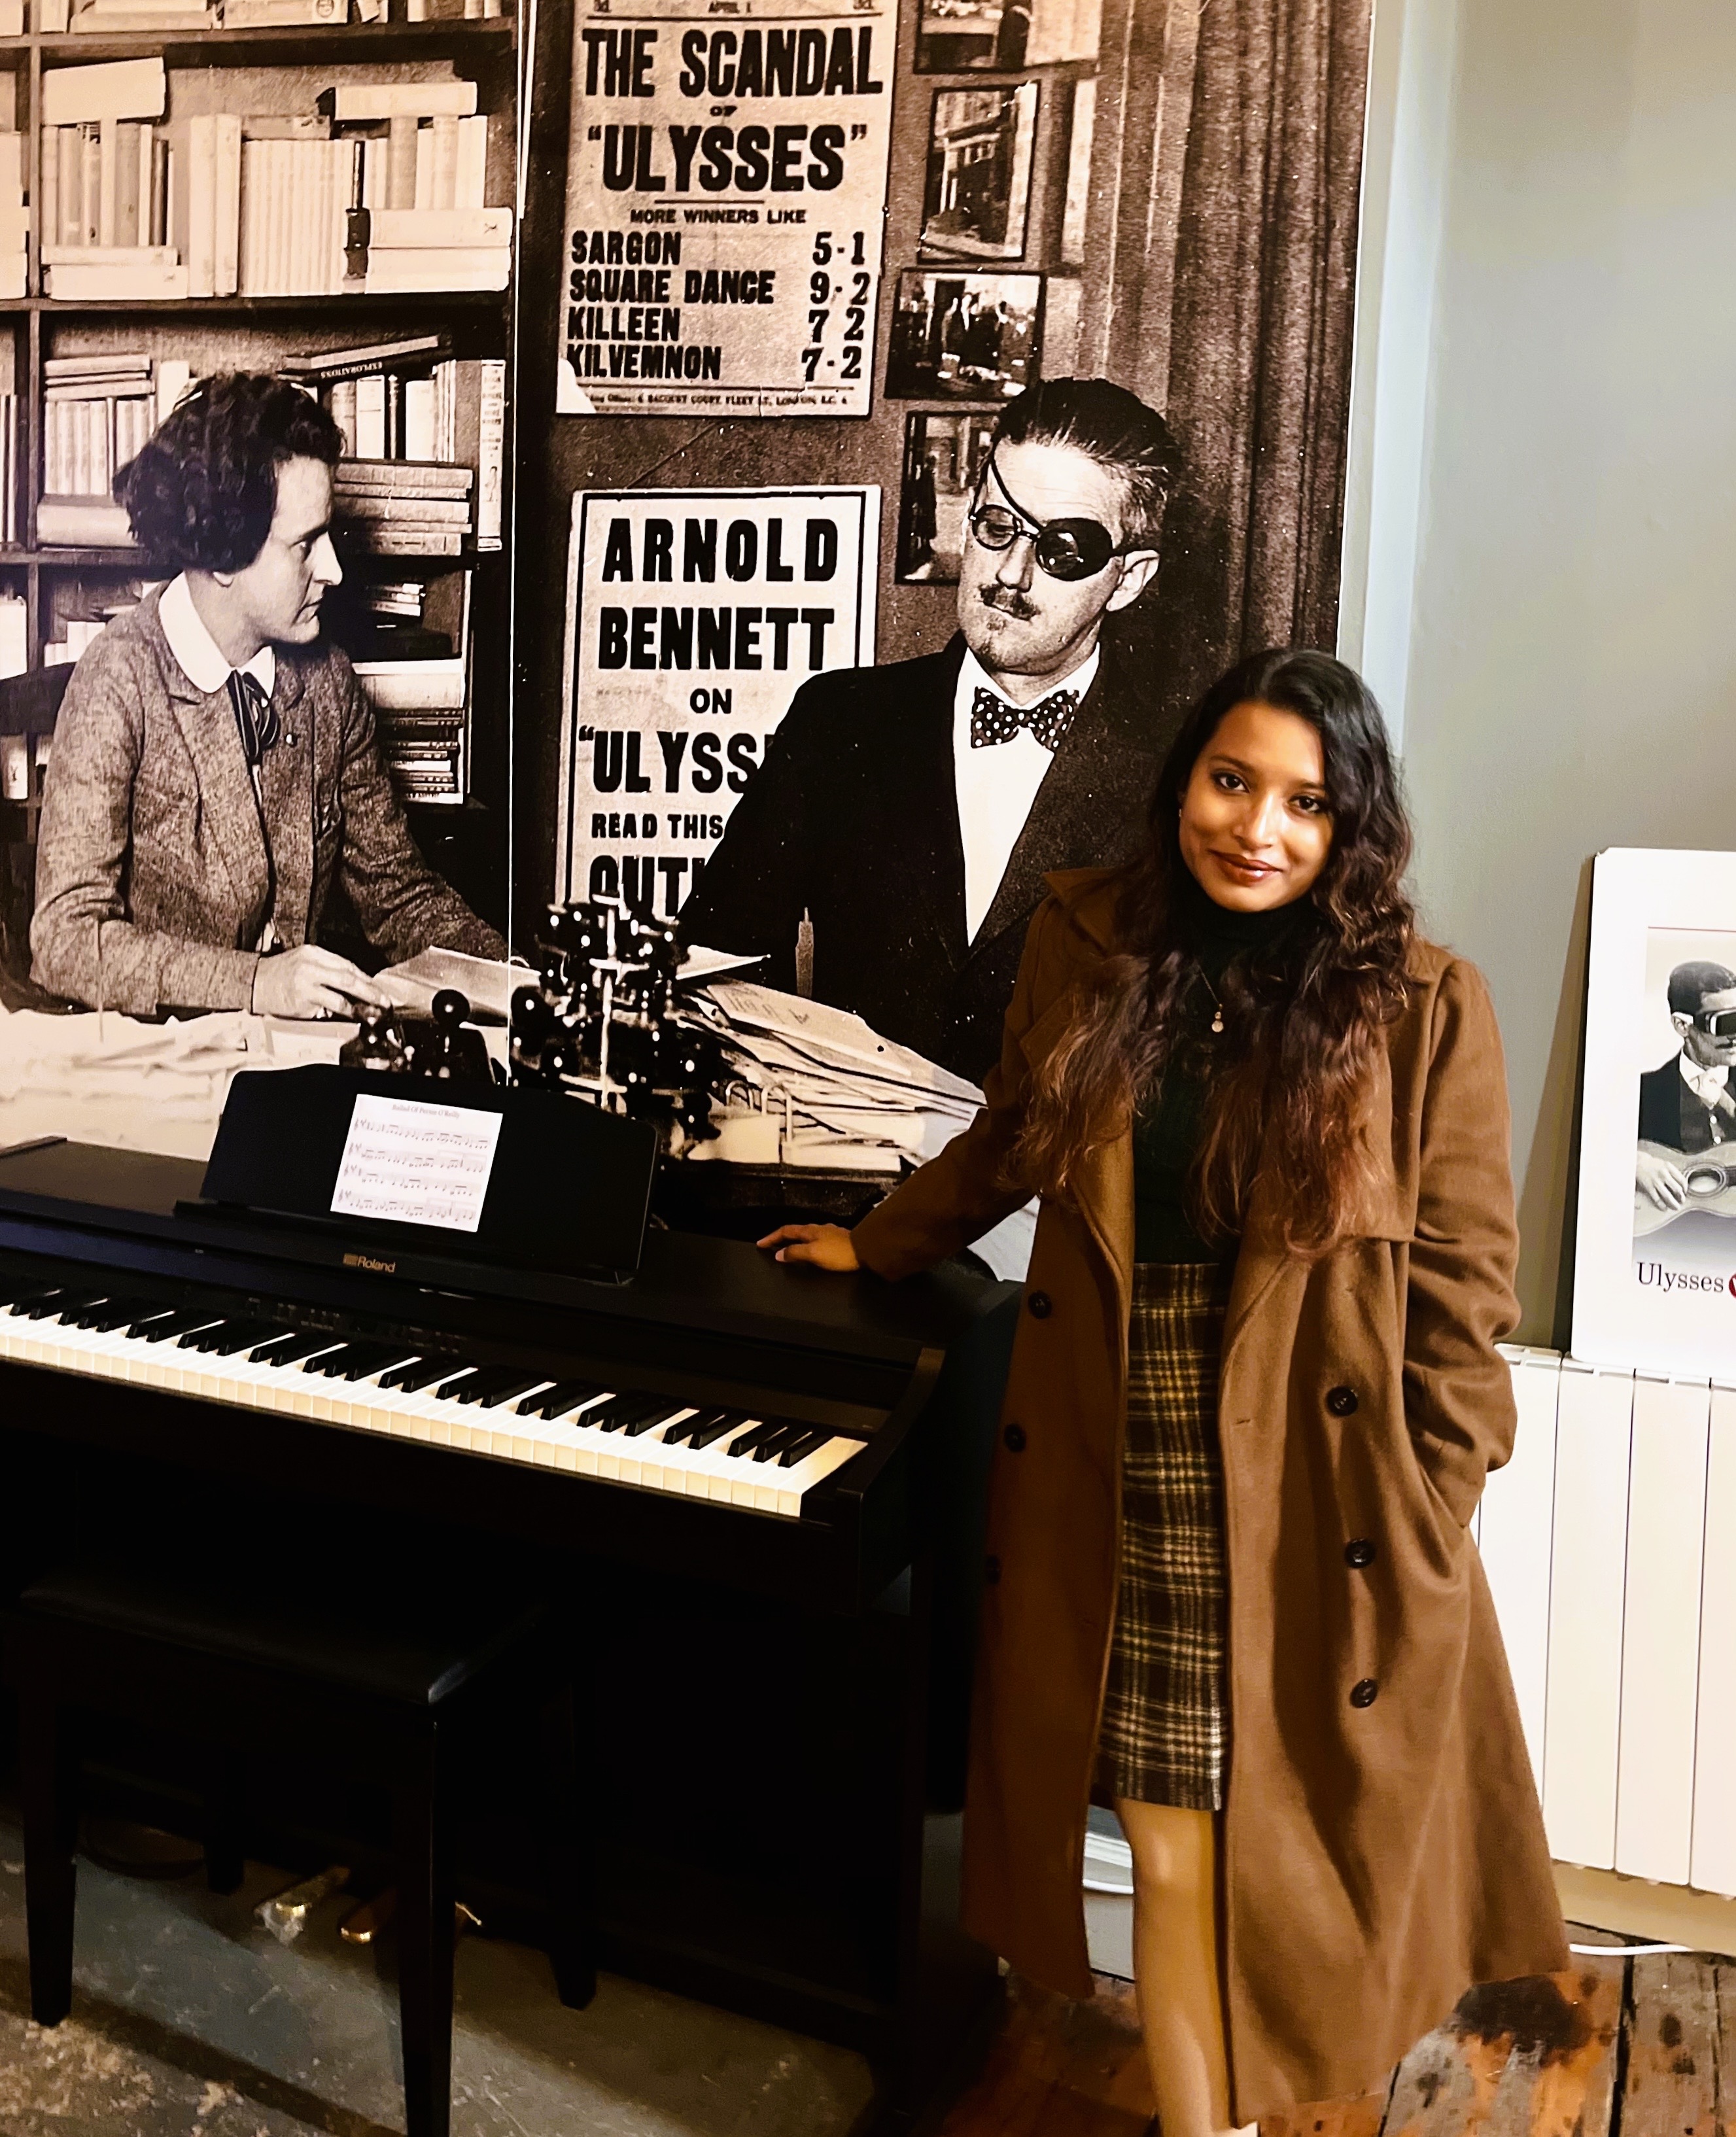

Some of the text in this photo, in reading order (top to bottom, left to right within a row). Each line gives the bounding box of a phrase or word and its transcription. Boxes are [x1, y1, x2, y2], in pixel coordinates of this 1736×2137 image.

[582, 26, 883, 97] THE SCANDAL
[710, 105, 738, 117] OF
[630, 209, 807, 224] MORE WINNERS LIKE
[572, 230, 681, 264] SARGON
[570, 269, 671, 302] SQUARE
[684, 270, 775, 304] DANCE
[568, 307, 680, 341] KILLEEN
[567, 345, 721, 379] KILVEMNON
[602, 519, 838, 582] ARNOLD
[599, 607, 834, 671] BENNETT
[689, 688, 732, 714] ON
[591, 813, 723, 839] READ THIS
[589, 855, 704, 916] OUT
[357, 1255, 396, 1273] Roland
[1637, 1261, 1724, 1293] Ulysses
